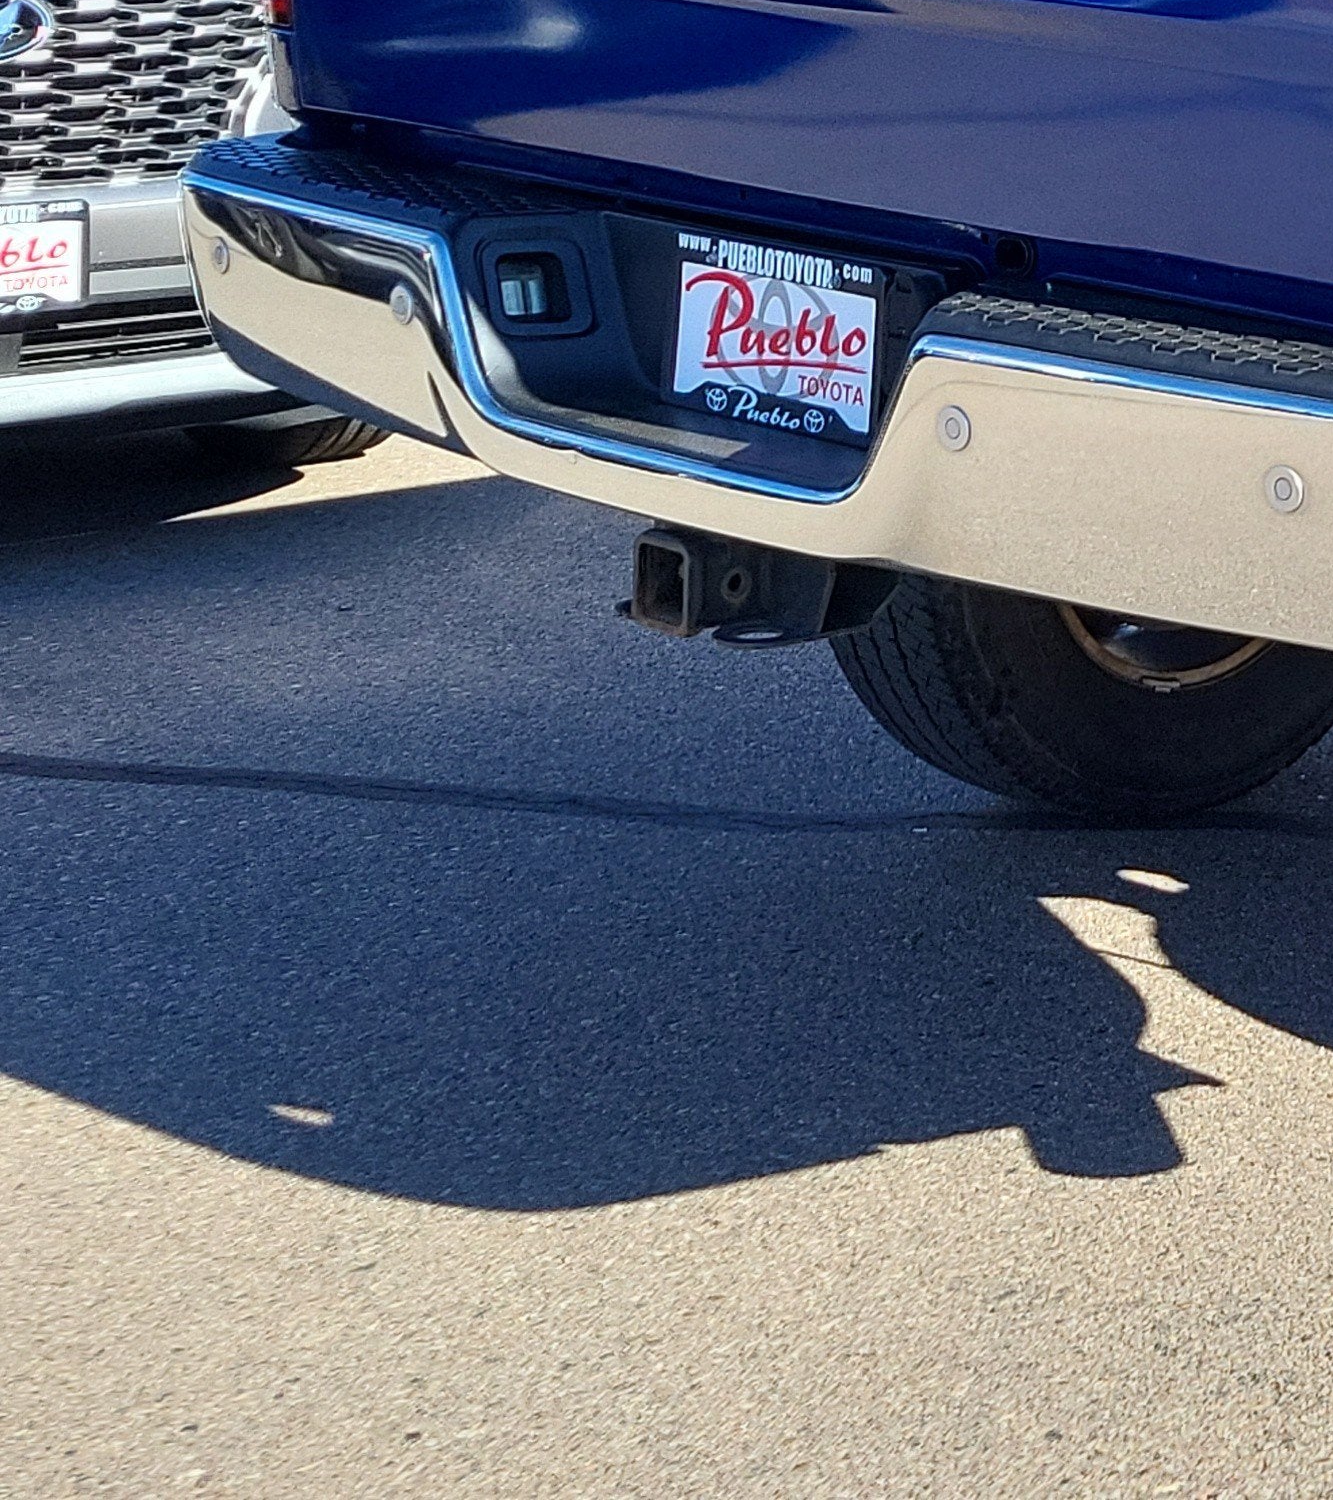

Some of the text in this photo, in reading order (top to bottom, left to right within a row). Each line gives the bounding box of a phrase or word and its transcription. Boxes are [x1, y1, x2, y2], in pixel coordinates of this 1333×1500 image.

[5, 275, 68, 293] TOYOTA
[685, 271, 867, 358] Pueblo
[728, 385, 801, 430] Pueblo
[798, 375, 864, 407] TOYOTA
